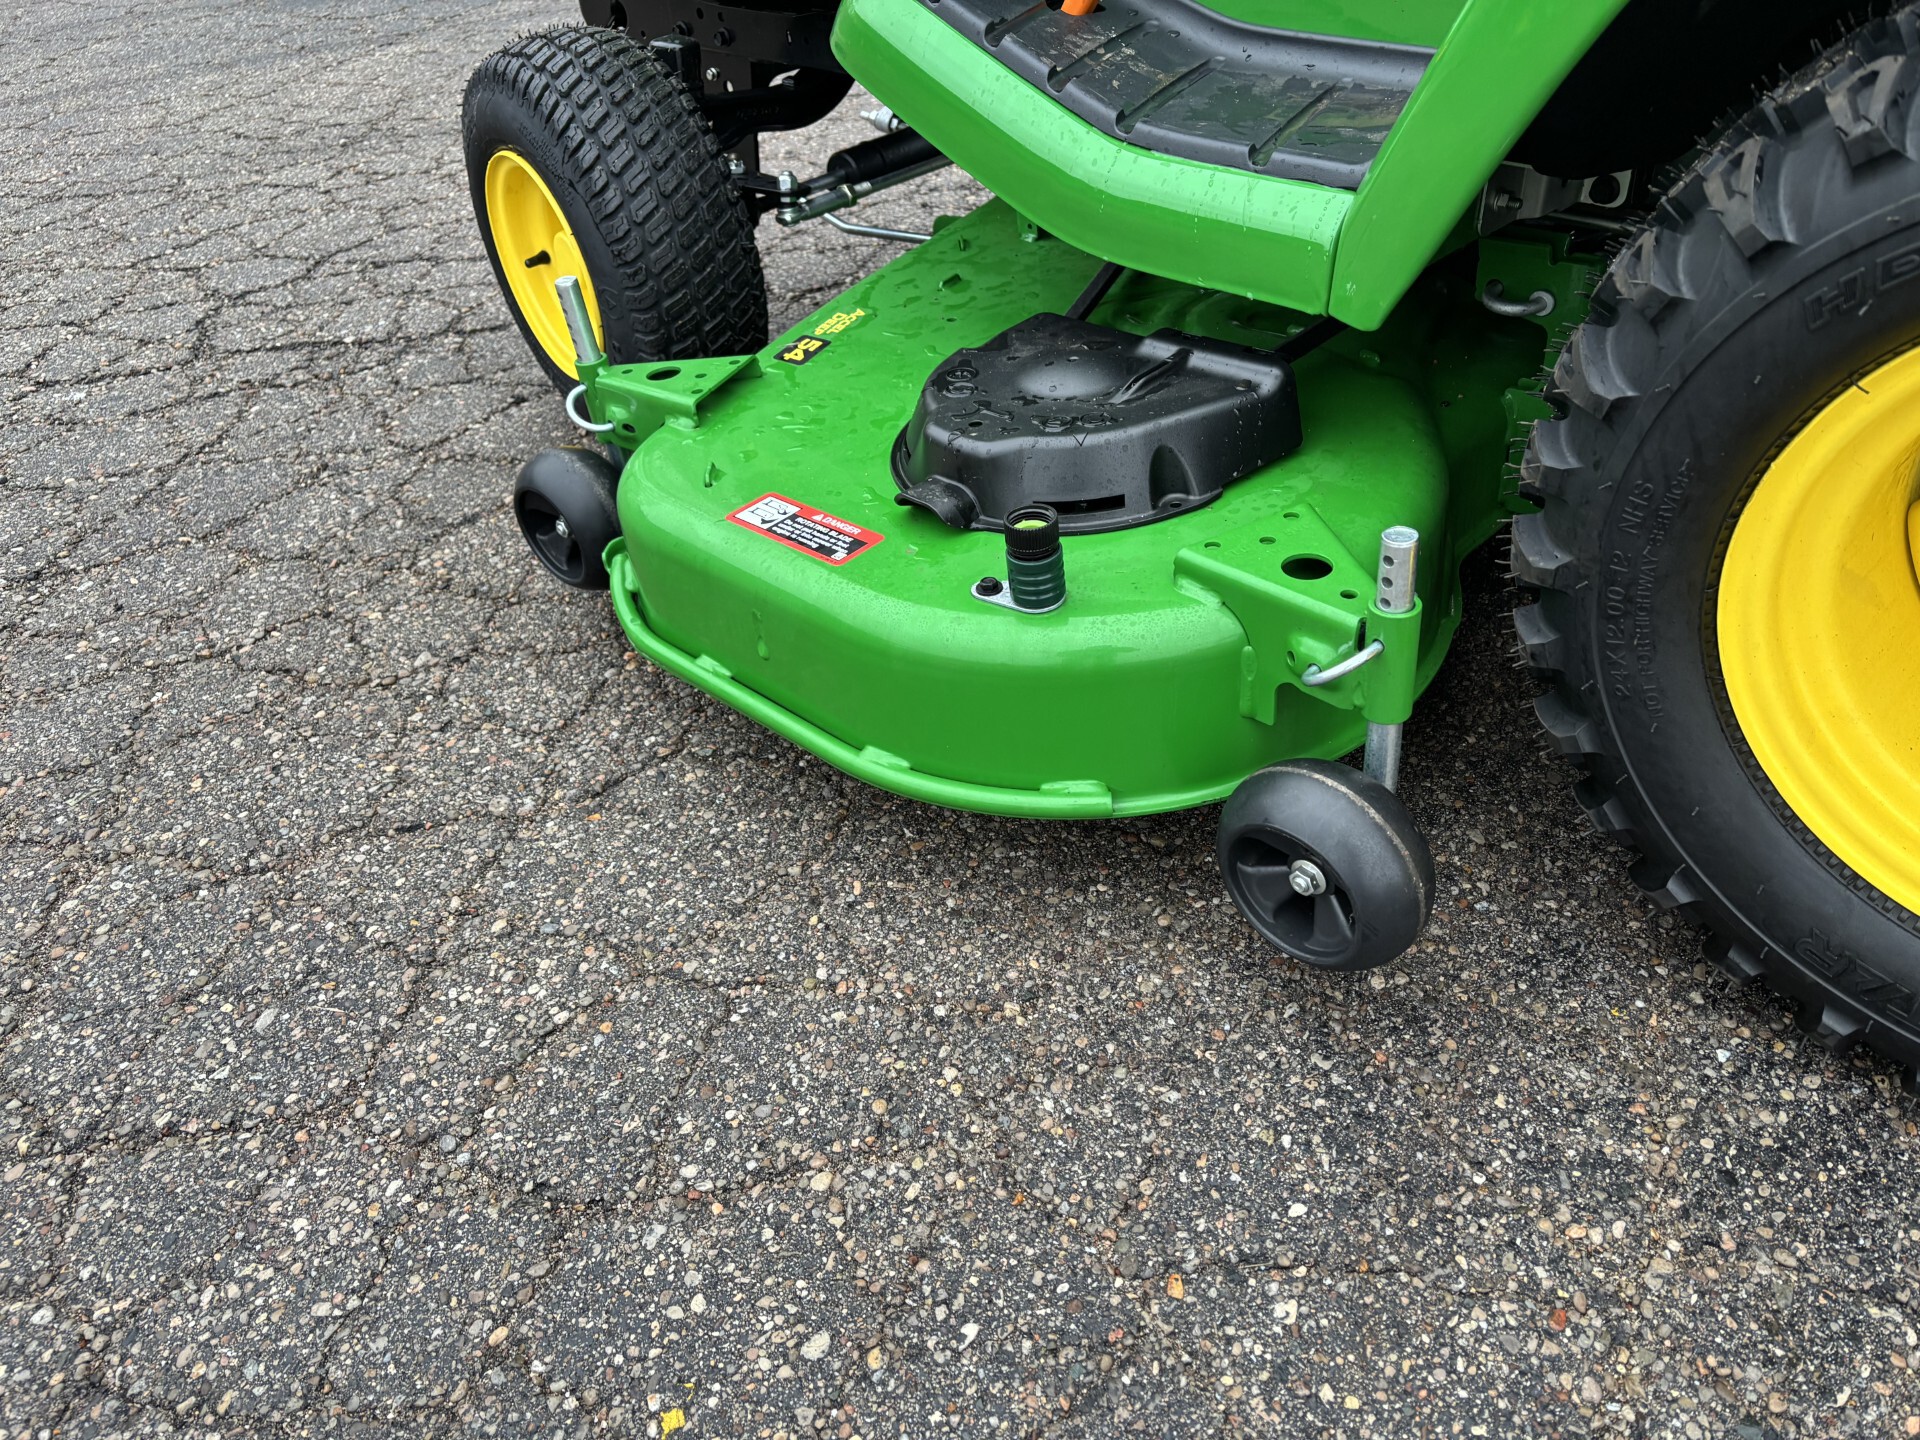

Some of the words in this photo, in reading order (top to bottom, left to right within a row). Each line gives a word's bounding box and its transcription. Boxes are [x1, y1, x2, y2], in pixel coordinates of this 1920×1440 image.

[783, 338, 823, 361] 54
[1618, 480, 1654, 534] NHS
[795, 517, 830, 533] ROTATING
[828, 530, 854, 543] BLADE
[822, 516, 862, 536] DANGER
[1634, 551, 1660, 634] HIGHWAY
